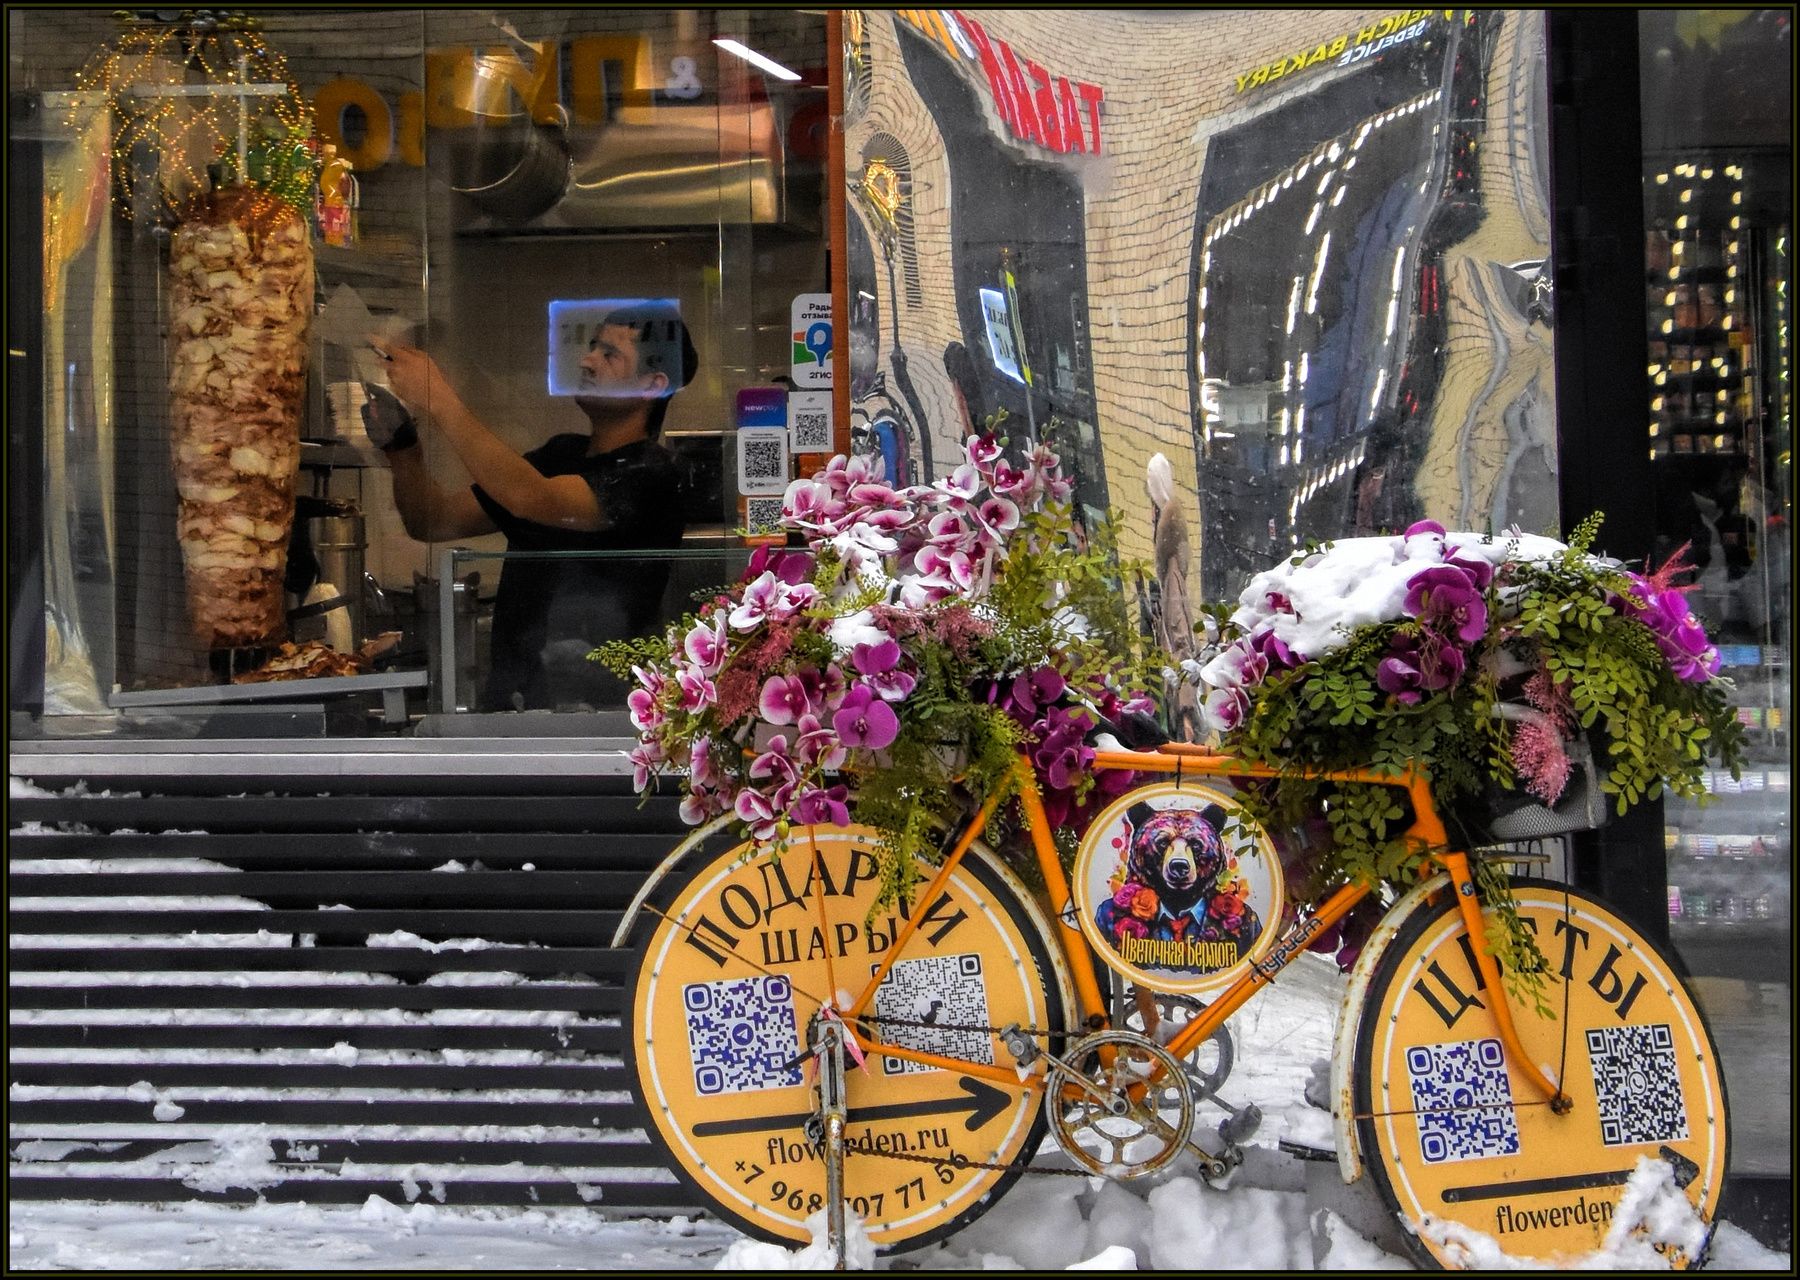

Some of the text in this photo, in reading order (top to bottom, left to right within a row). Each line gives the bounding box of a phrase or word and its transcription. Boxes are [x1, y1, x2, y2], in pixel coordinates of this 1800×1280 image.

[809, 371, 832, 379] 2ГИС
[760, 917, 899, 966] ШАРЫ
[1121, 930, 1238, 973] Цветочная Берлога
[766, 1127, 950, 1166] flowrden.ru
[734, 1160, 765, 1185] +7
[844, 1193, 884, 1219] 07
[895, 1176, 926, 1209] 77
